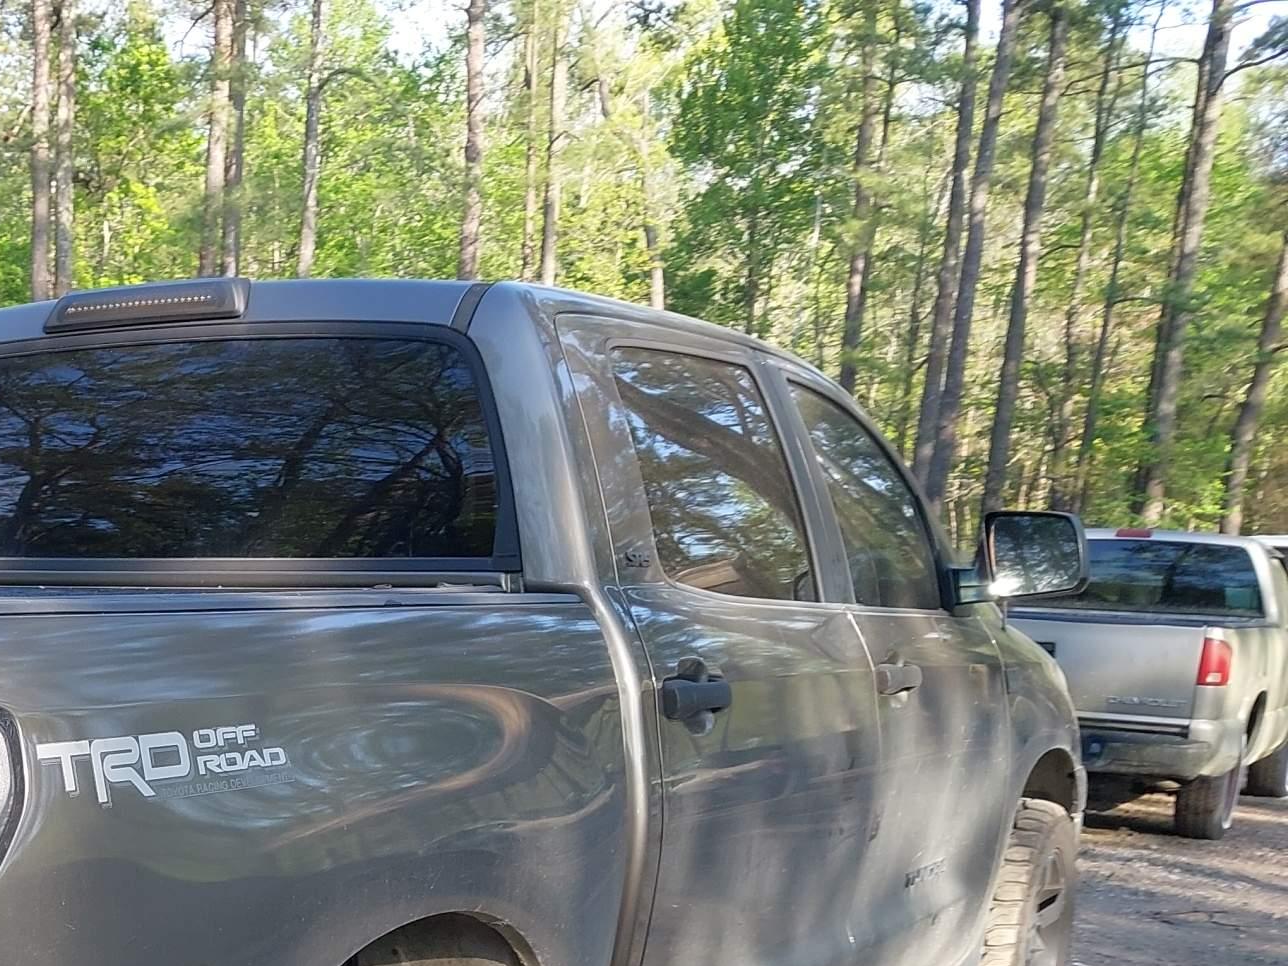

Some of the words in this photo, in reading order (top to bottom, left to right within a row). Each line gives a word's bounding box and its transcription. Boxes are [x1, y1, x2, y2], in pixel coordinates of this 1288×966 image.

[37, 732, 191, 804] TRD
[193, 724, 258, 749] OFF
[198, 747, 287, 776] ROAD
